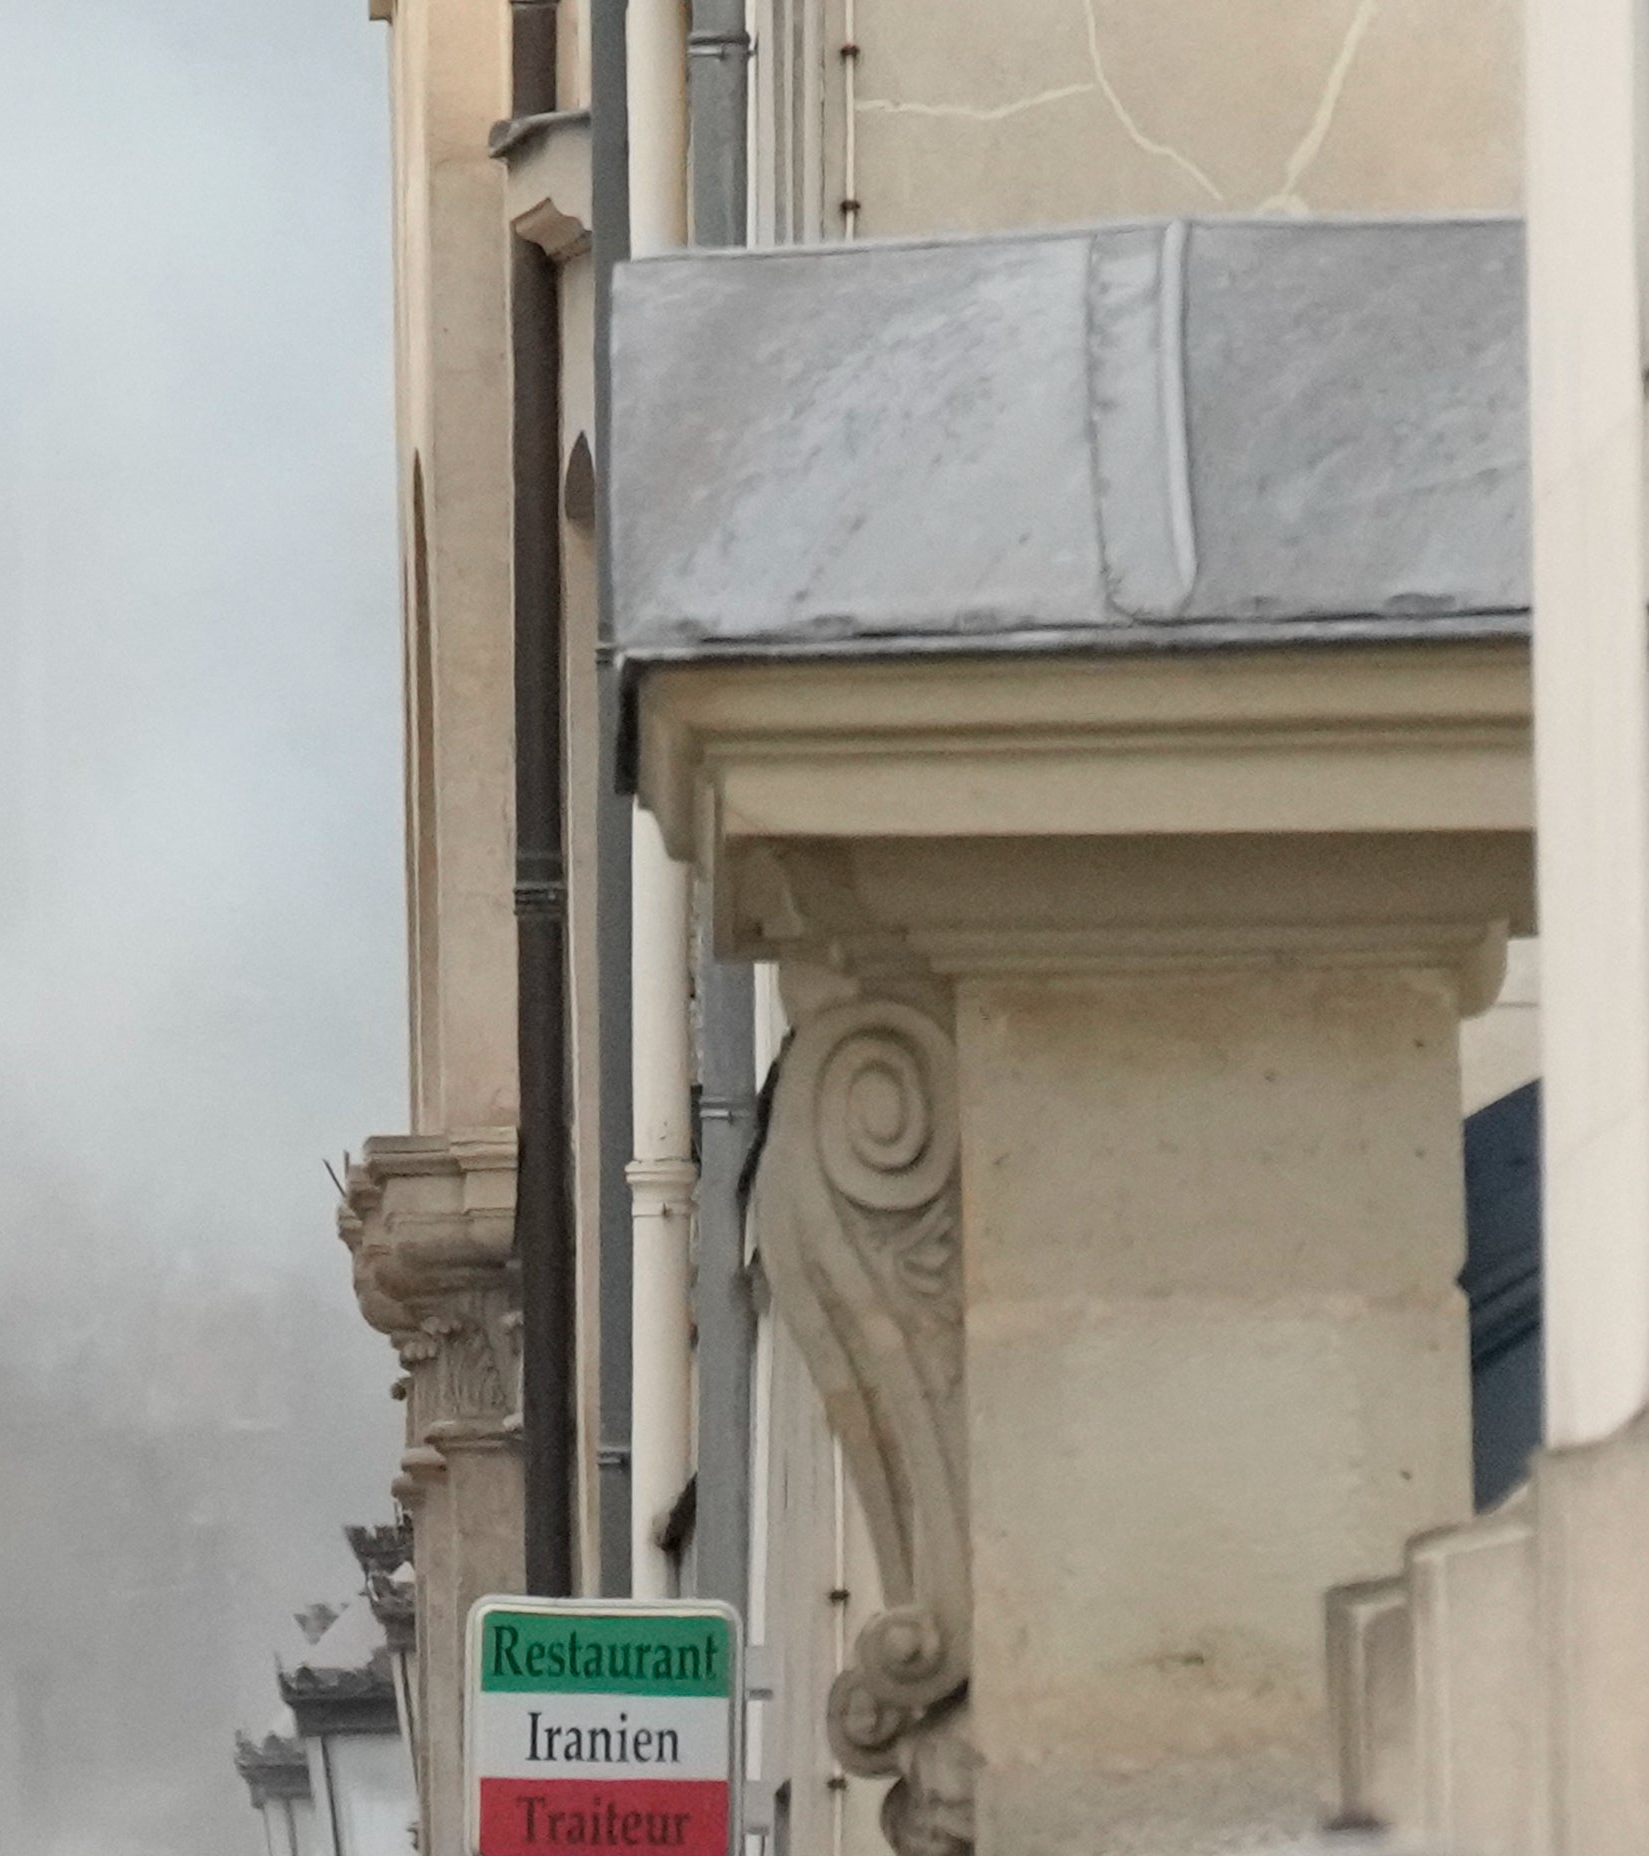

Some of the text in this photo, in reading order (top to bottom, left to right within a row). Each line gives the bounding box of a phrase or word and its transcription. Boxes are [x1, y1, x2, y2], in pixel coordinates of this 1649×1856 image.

[492, 1625, 720, 1682] Restaurant
[526, 1711, 680, 1764] Iranien
[516, 1796, 692, 1846] Traiteur
